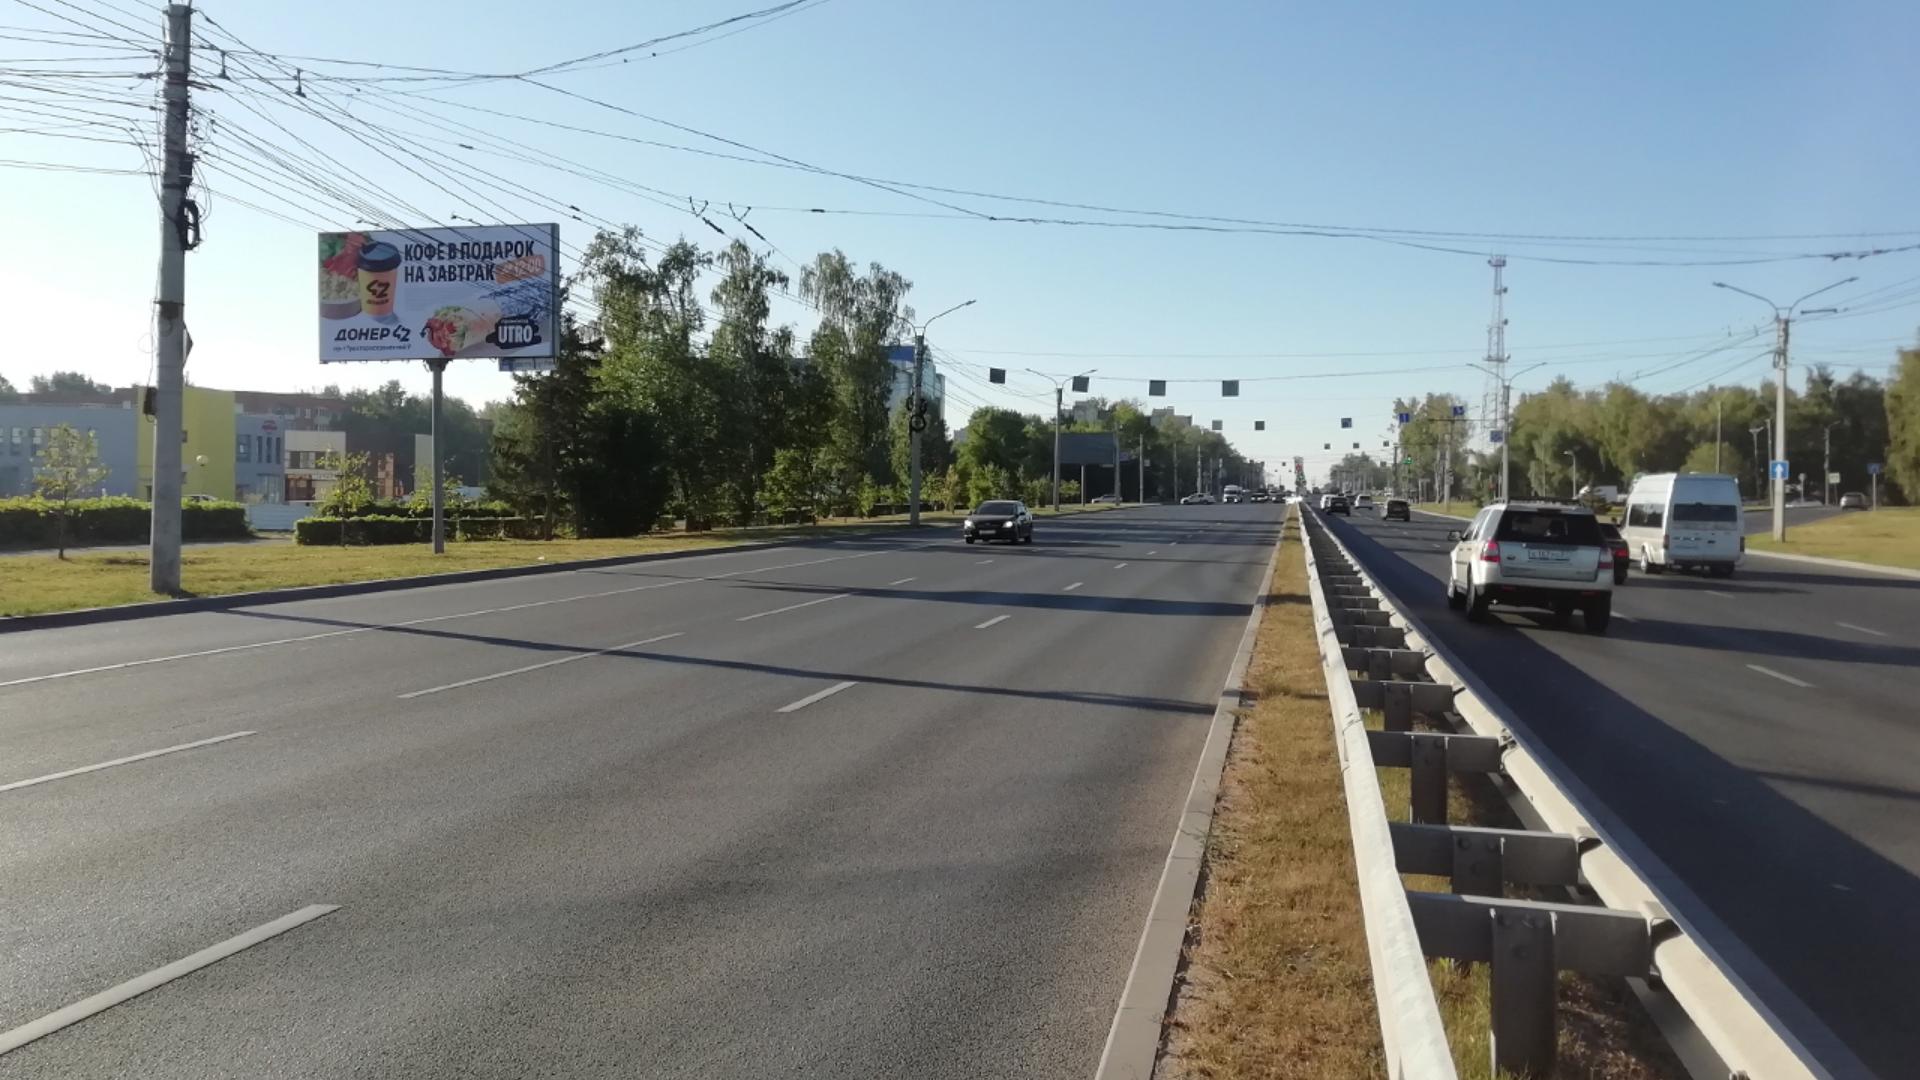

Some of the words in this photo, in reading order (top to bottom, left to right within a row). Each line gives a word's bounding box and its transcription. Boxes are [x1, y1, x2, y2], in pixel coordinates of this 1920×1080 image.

[404, 243, 445, 261] КОФЕ
[448, 242, 457, 259] В
[460, 241, 535, 261] ПОДАРОК
[404, 265, 425, 283] НА
[428, 263, 496, 282] ЗАВТРАК
[334, 327, 391, 341] ДОНЕР
[498, 324, 534, 344] UTRO
